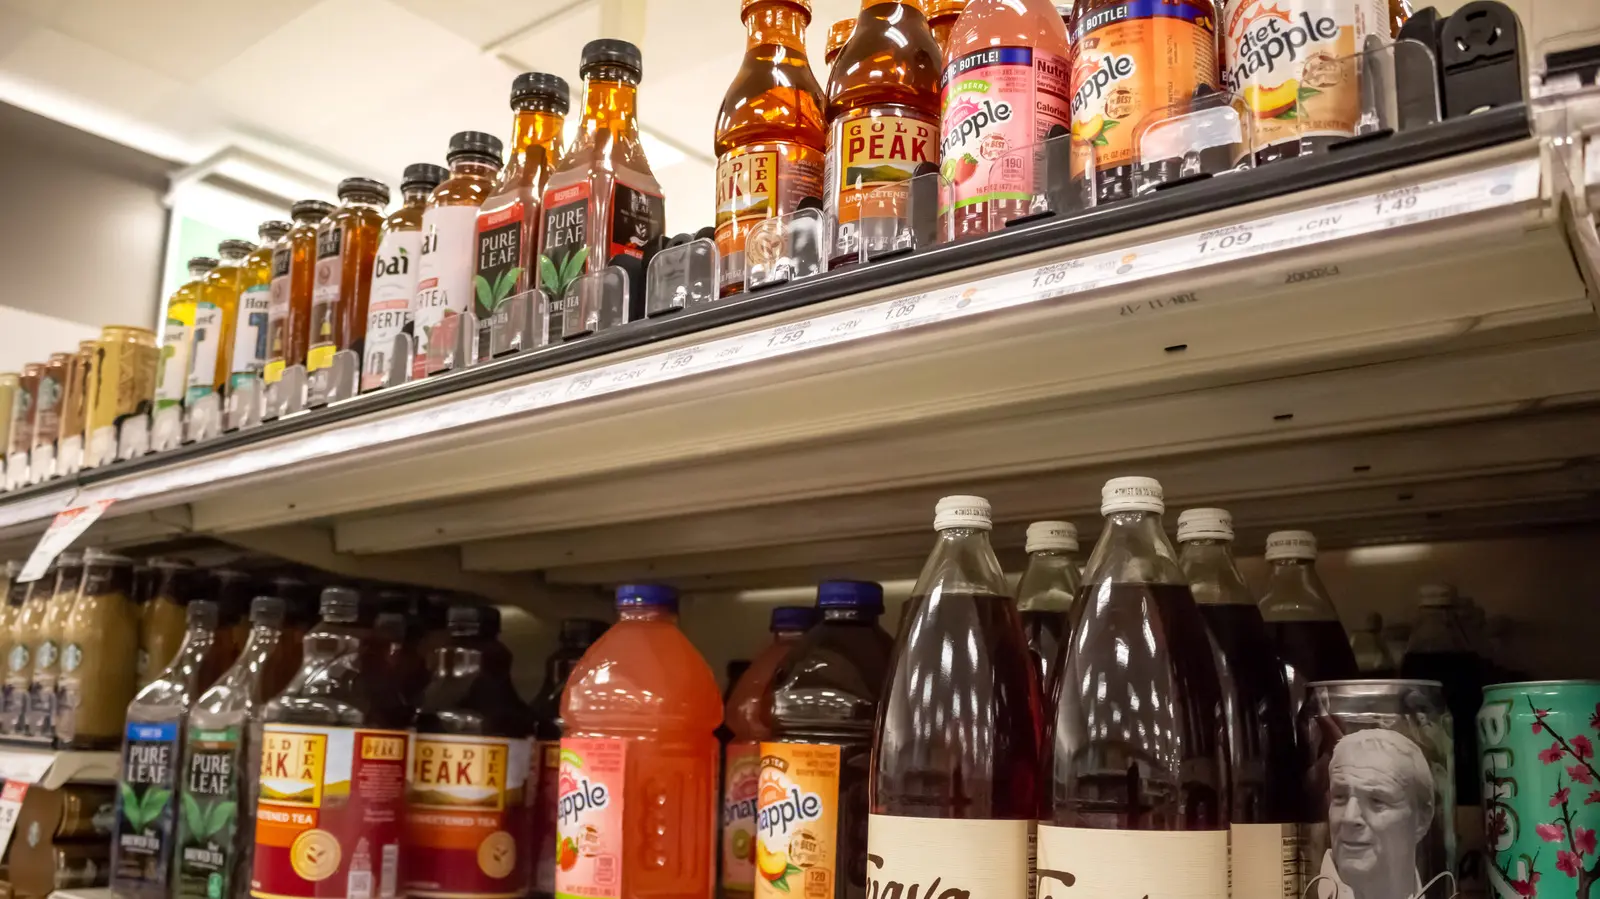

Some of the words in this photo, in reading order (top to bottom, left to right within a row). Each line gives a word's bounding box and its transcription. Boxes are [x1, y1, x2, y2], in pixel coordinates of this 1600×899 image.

[1086, 6, 1128, 29] BOTTLE!
[1241, 18, 1281, 57] diet
[960, 51, 999, 71] BOTTLE!
[850, 121, 929, 137] GOLD
[849, 134, 928, 163] PEAK
[1005, 158, 1022, 169] 190
[1374, 196, 1417, 215] 1.49
[548, 207, 584, 232] PURE
[481, 229, 517, 254] PURE
[546, 225, 583, 249] LEAF
[1197, 232, 1253, 253] 1.09
[376, 252, 409, 278] bai
[480, 246, 516, 270] LEAF
[1032, 271, 1066, 288] 1.09
[886, 303, 916, 320] 1.09
[767, 330, 805, 347] 1.59
[660, 355, 693, 371] 1.59
[130, 746, 168, 764] PURE
[422, 746, 475, 760] OLD
[192, 753, 230, 774] PURE
[127, 764, 165, 783] LEAF
[190, 774, 228, 794] LEAF
[291, 813, 313, 824] TEA
[811, 872, 826, 882] 120
